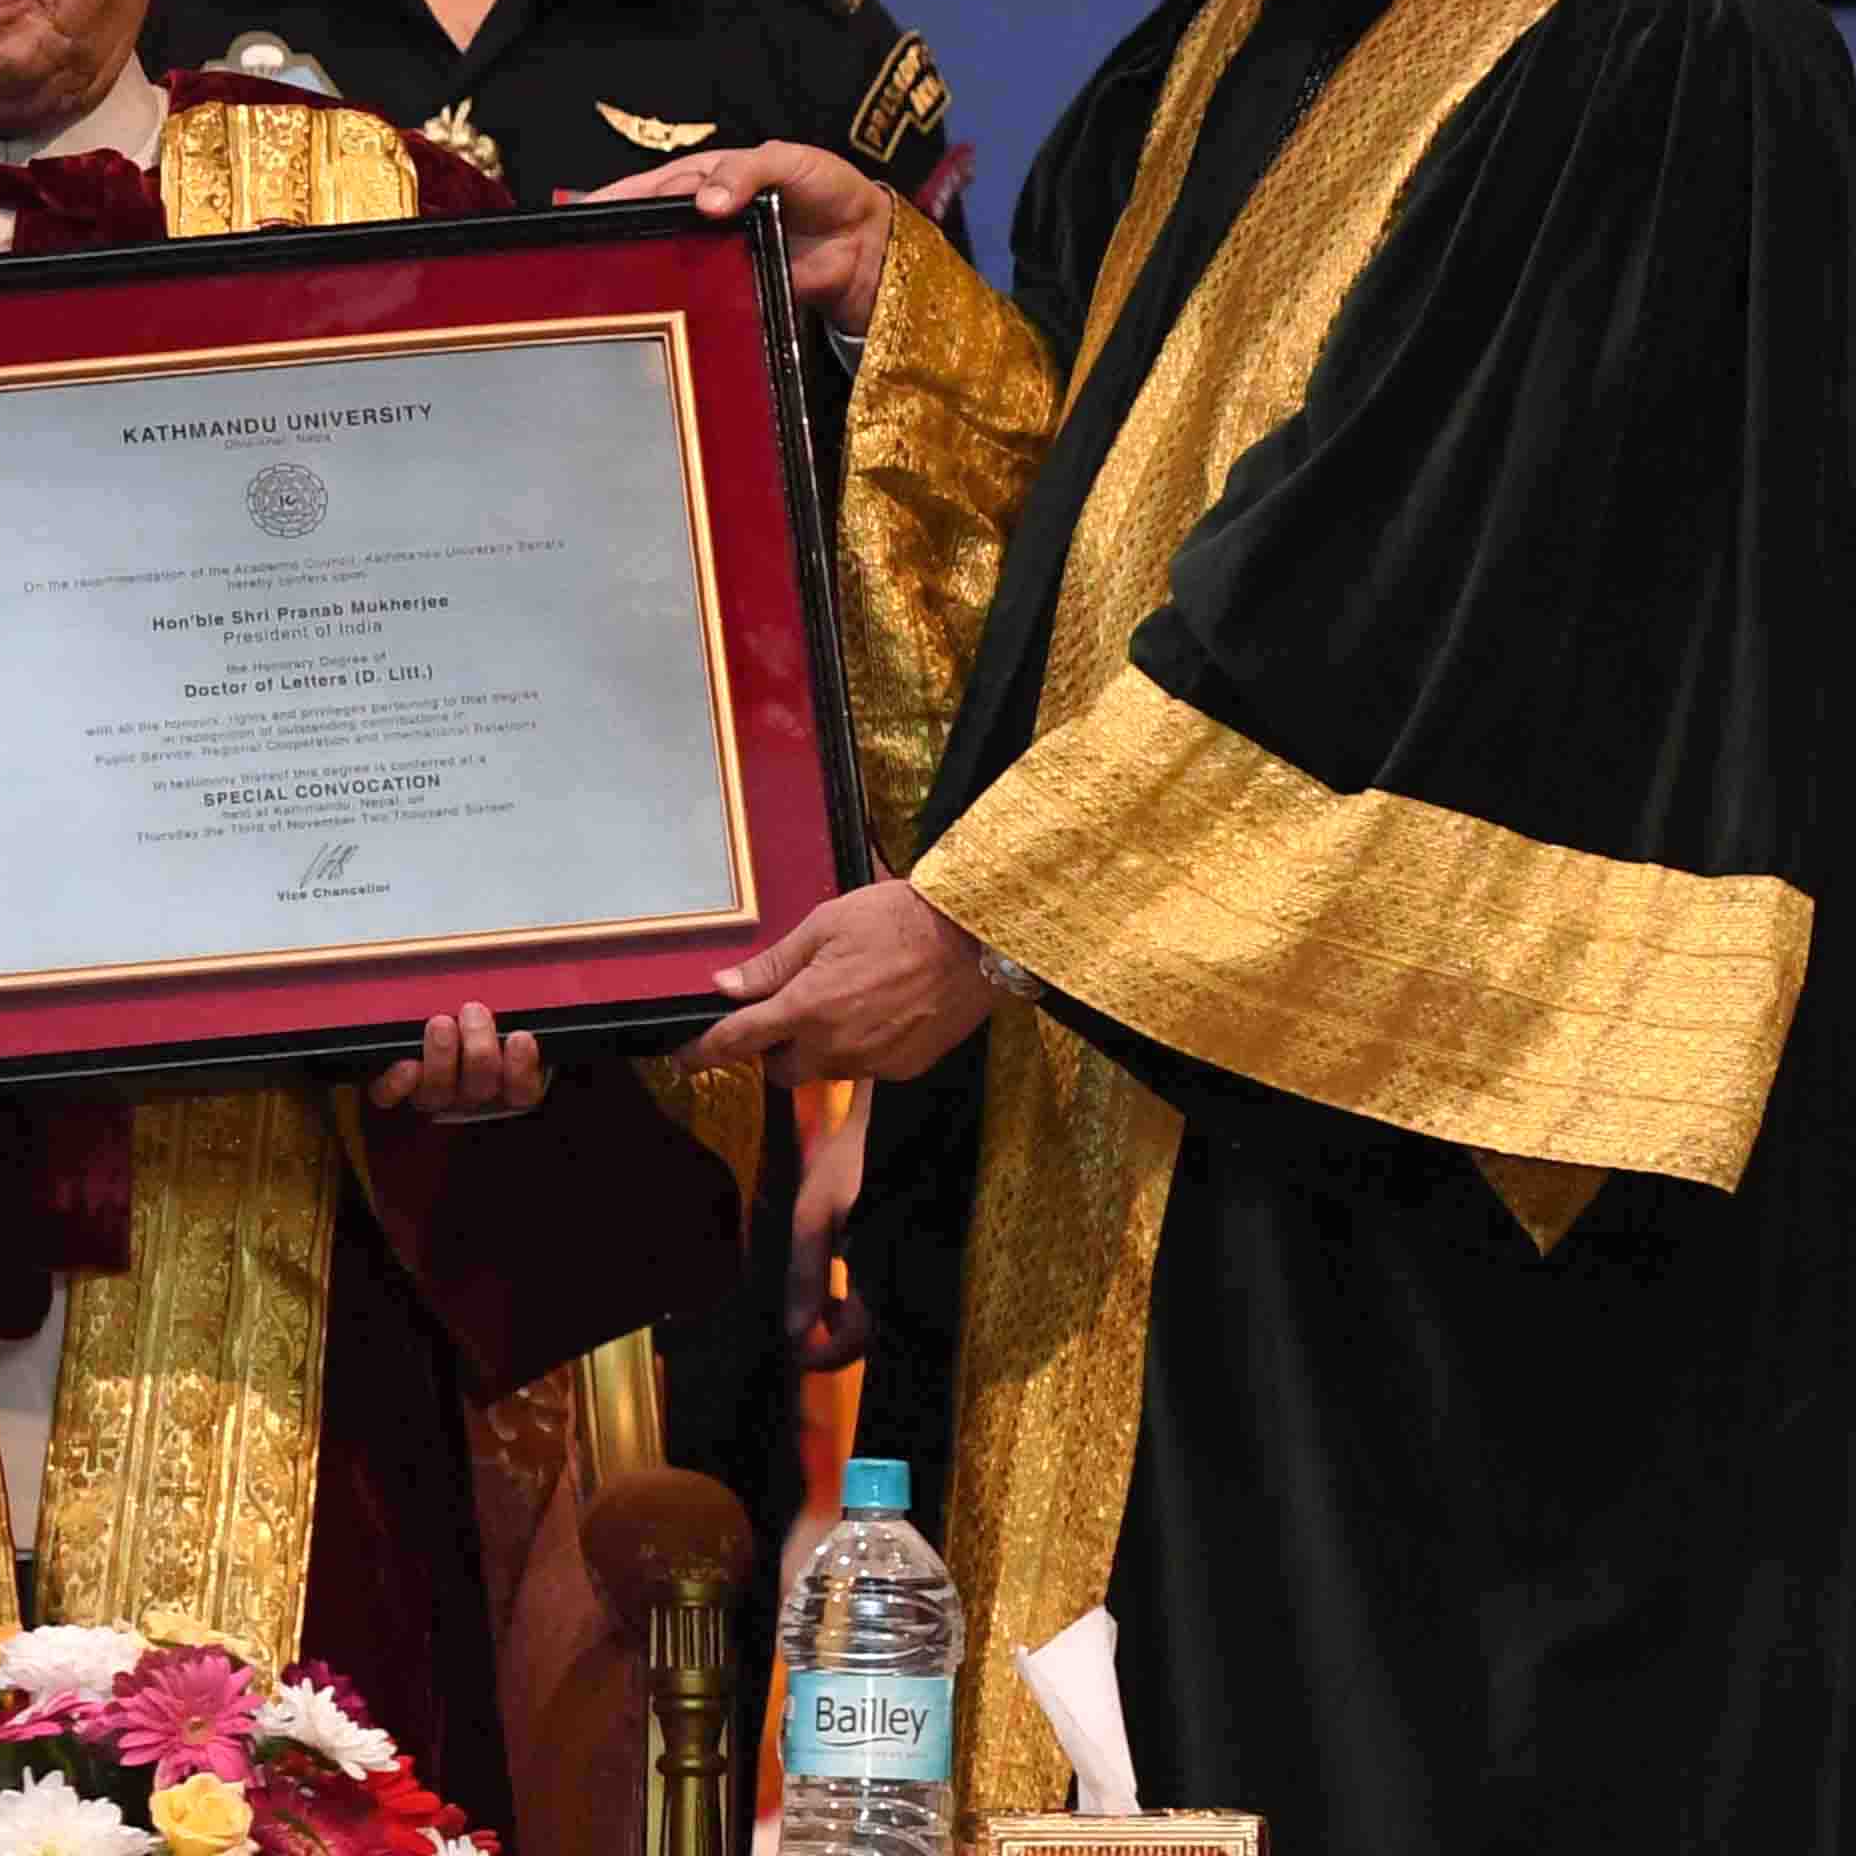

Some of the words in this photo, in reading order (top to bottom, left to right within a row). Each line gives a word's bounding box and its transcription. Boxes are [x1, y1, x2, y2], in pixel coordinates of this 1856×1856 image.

[121, 415, 277, 444] KATHMANDU
[287, 403, 432, 430] UNIVERSITY
[152, 612, 224, 631] Hon'ble
[231, 608, 269, 624] Shri
[276, 602, 343, 620] Pranab
[350, 594, 449, 617] Mukherjee
[223, 625, 308, 645] President
[315, 623, 331, 637] of
[338, 619, 382, 635] India
[184, 680, 247, 698] Doctor
[254, 677, 273, 692] of
[280, 671, 347, 690] Letters
[354, 668, 381, 686] (D.
[388, 664, 433, 683] Litt.)
[202, 786, 286, 807] SPECIAL
[294, 773, 440, 799] CONVOCATION
[816, 1696, 930, 1744] Bailley
